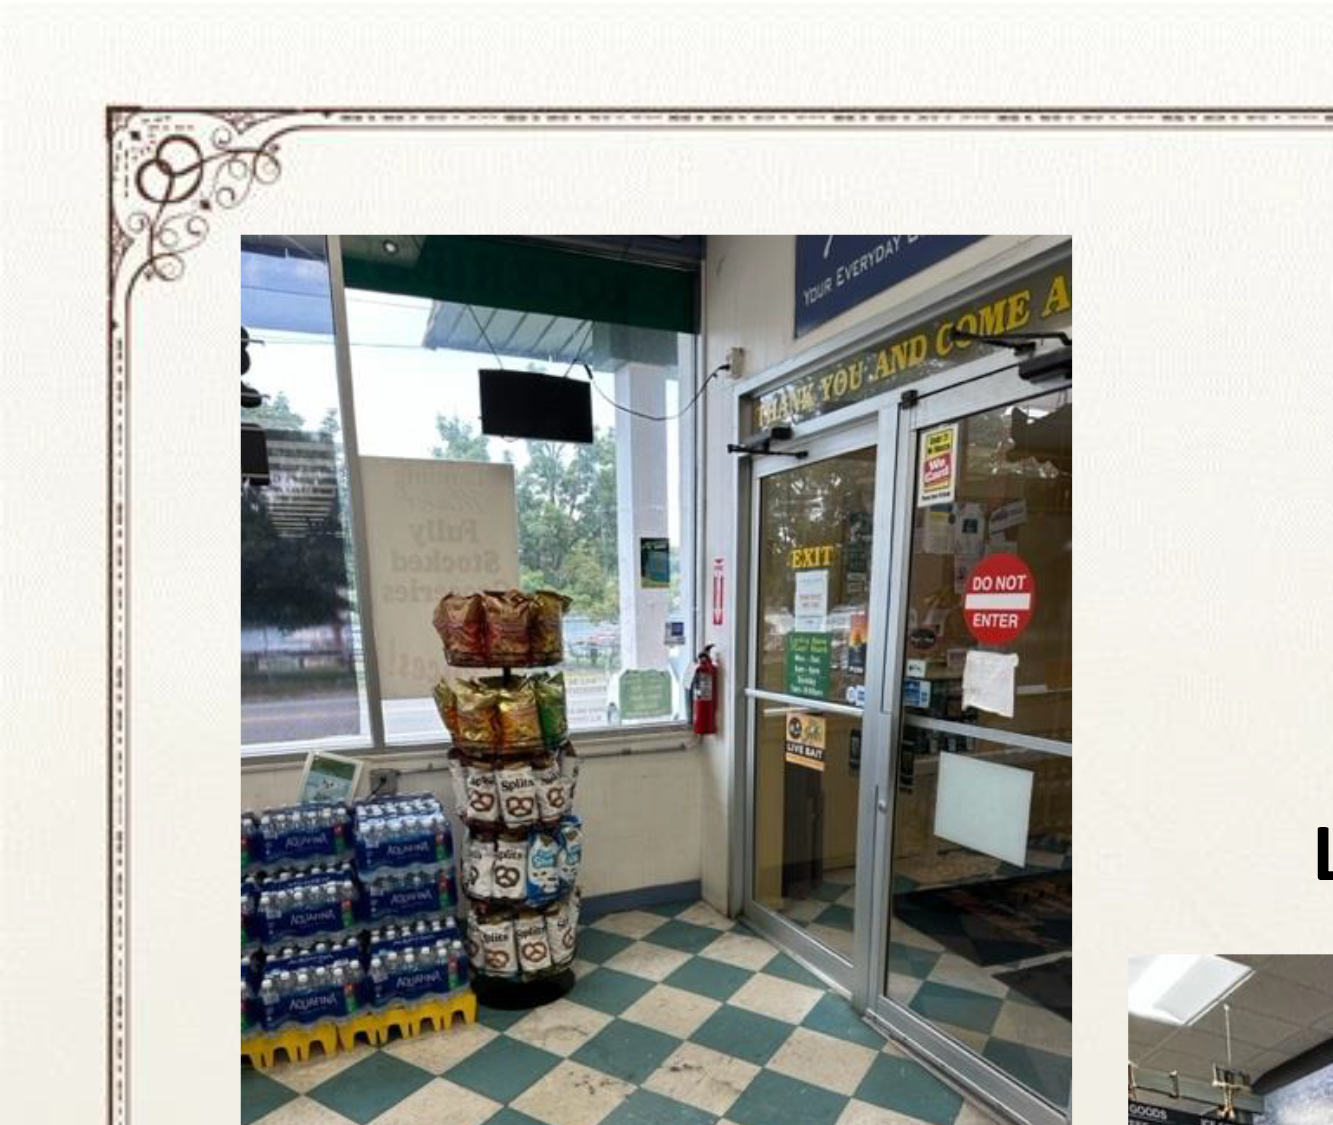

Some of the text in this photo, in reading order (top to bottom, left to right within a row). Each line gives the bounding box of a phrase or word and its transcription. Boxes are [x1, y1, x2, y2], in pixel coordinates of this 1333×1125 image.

[803, 237, 900, 306] YOUR EVERYDAY
[820, 361, 865, 401] YOU
[869, 334, 928, 383] AND
[936, 290, 1031, 357] COME
[791, 546, 834, 569] EXIT
[972, 574, 1027, 592] DO NOT
[972, 612, 1019, 629] ENTER
[1129, 1103, 1168, 1121] GOODS
